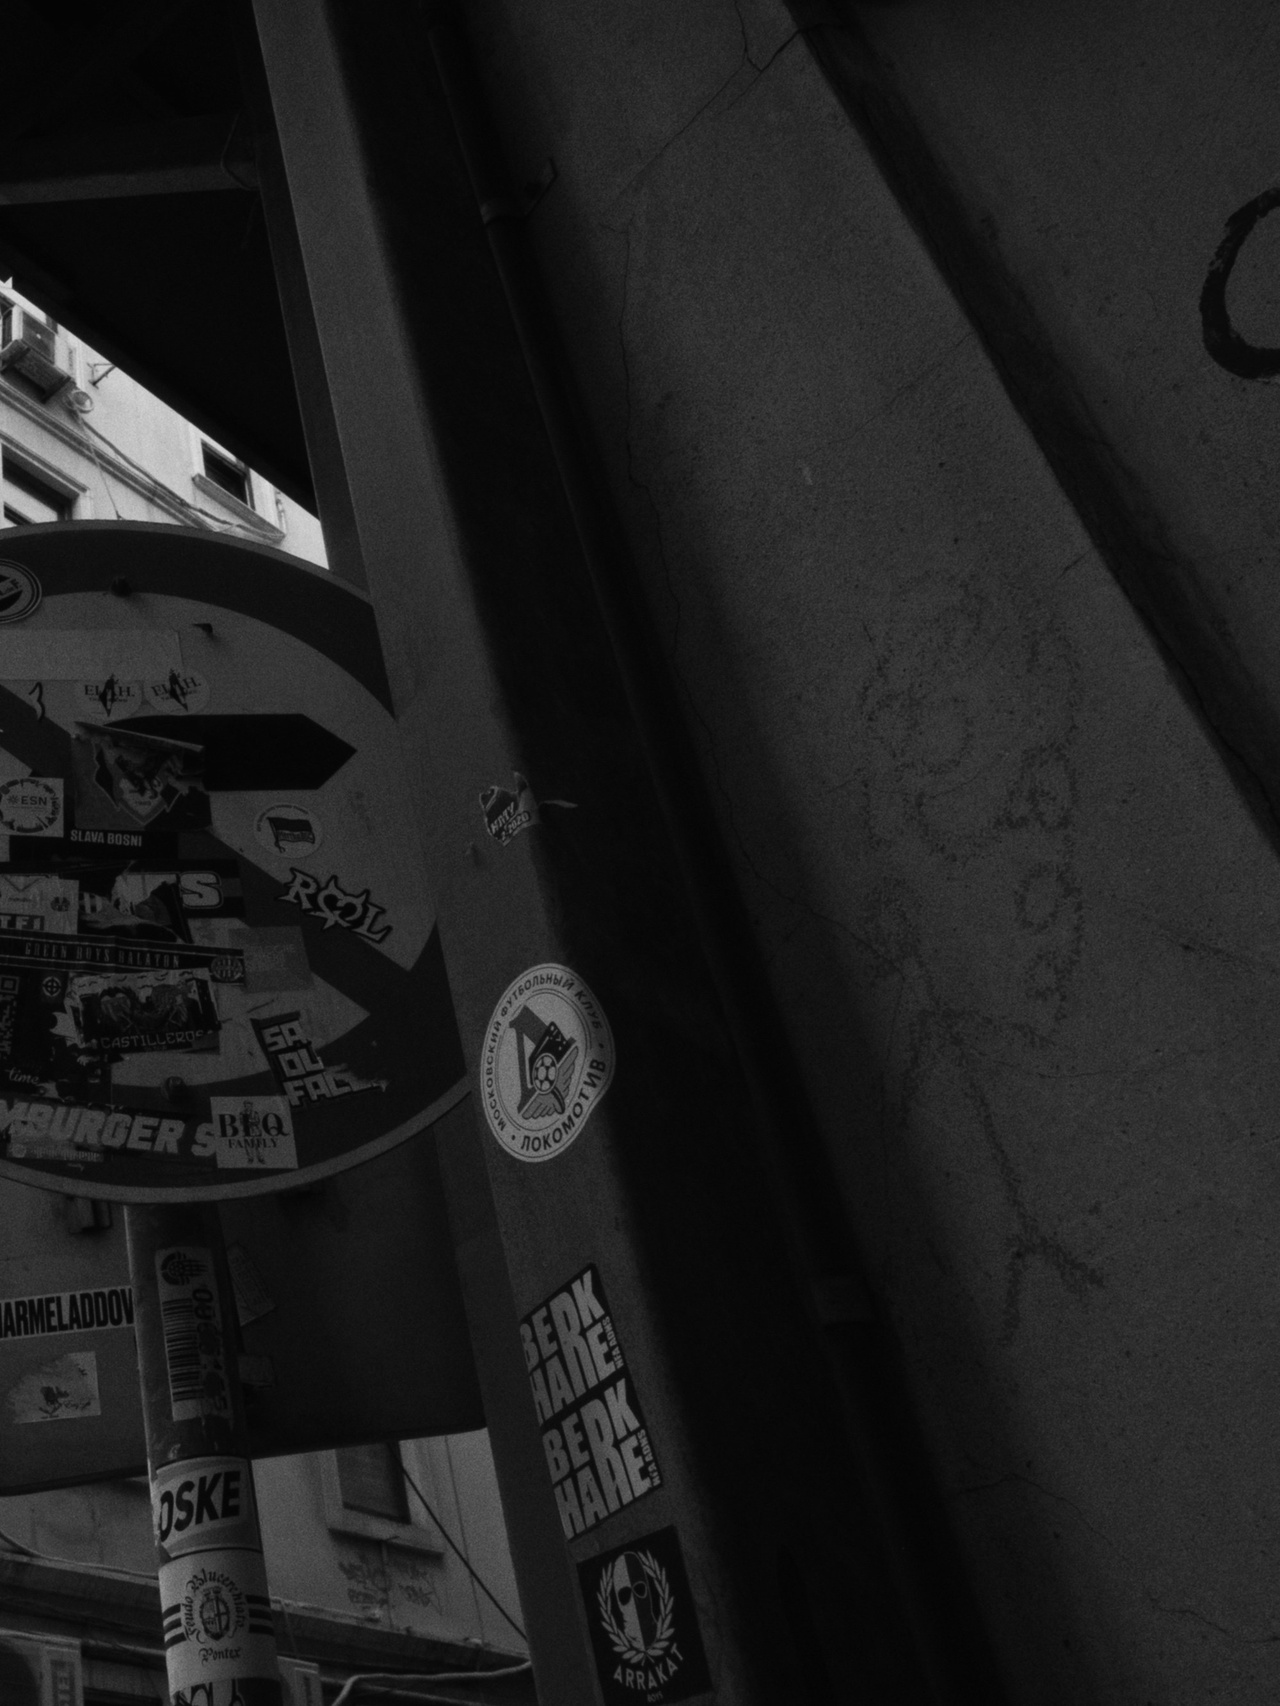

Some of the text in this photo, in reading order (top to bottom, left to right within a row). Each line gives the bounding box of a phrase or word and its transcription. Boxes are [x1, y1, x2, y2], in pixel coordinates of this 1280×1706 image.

[21, 795, 48, 806] ESN
[70, 830, 143, 848] SLAVA BOSNI
[24, 942, 180, 968] GREEN BOYS BALATON
[574, 987, 604, 1032] КЛУБ
[521, 1058, 608, 1153] ЛОКОМОТИВ
[228, 1138, 279, 1149] FAMILY
[541, 1377, 641, 1485] BERK
[613, 1642, 684, 1691] ARRAKAT
